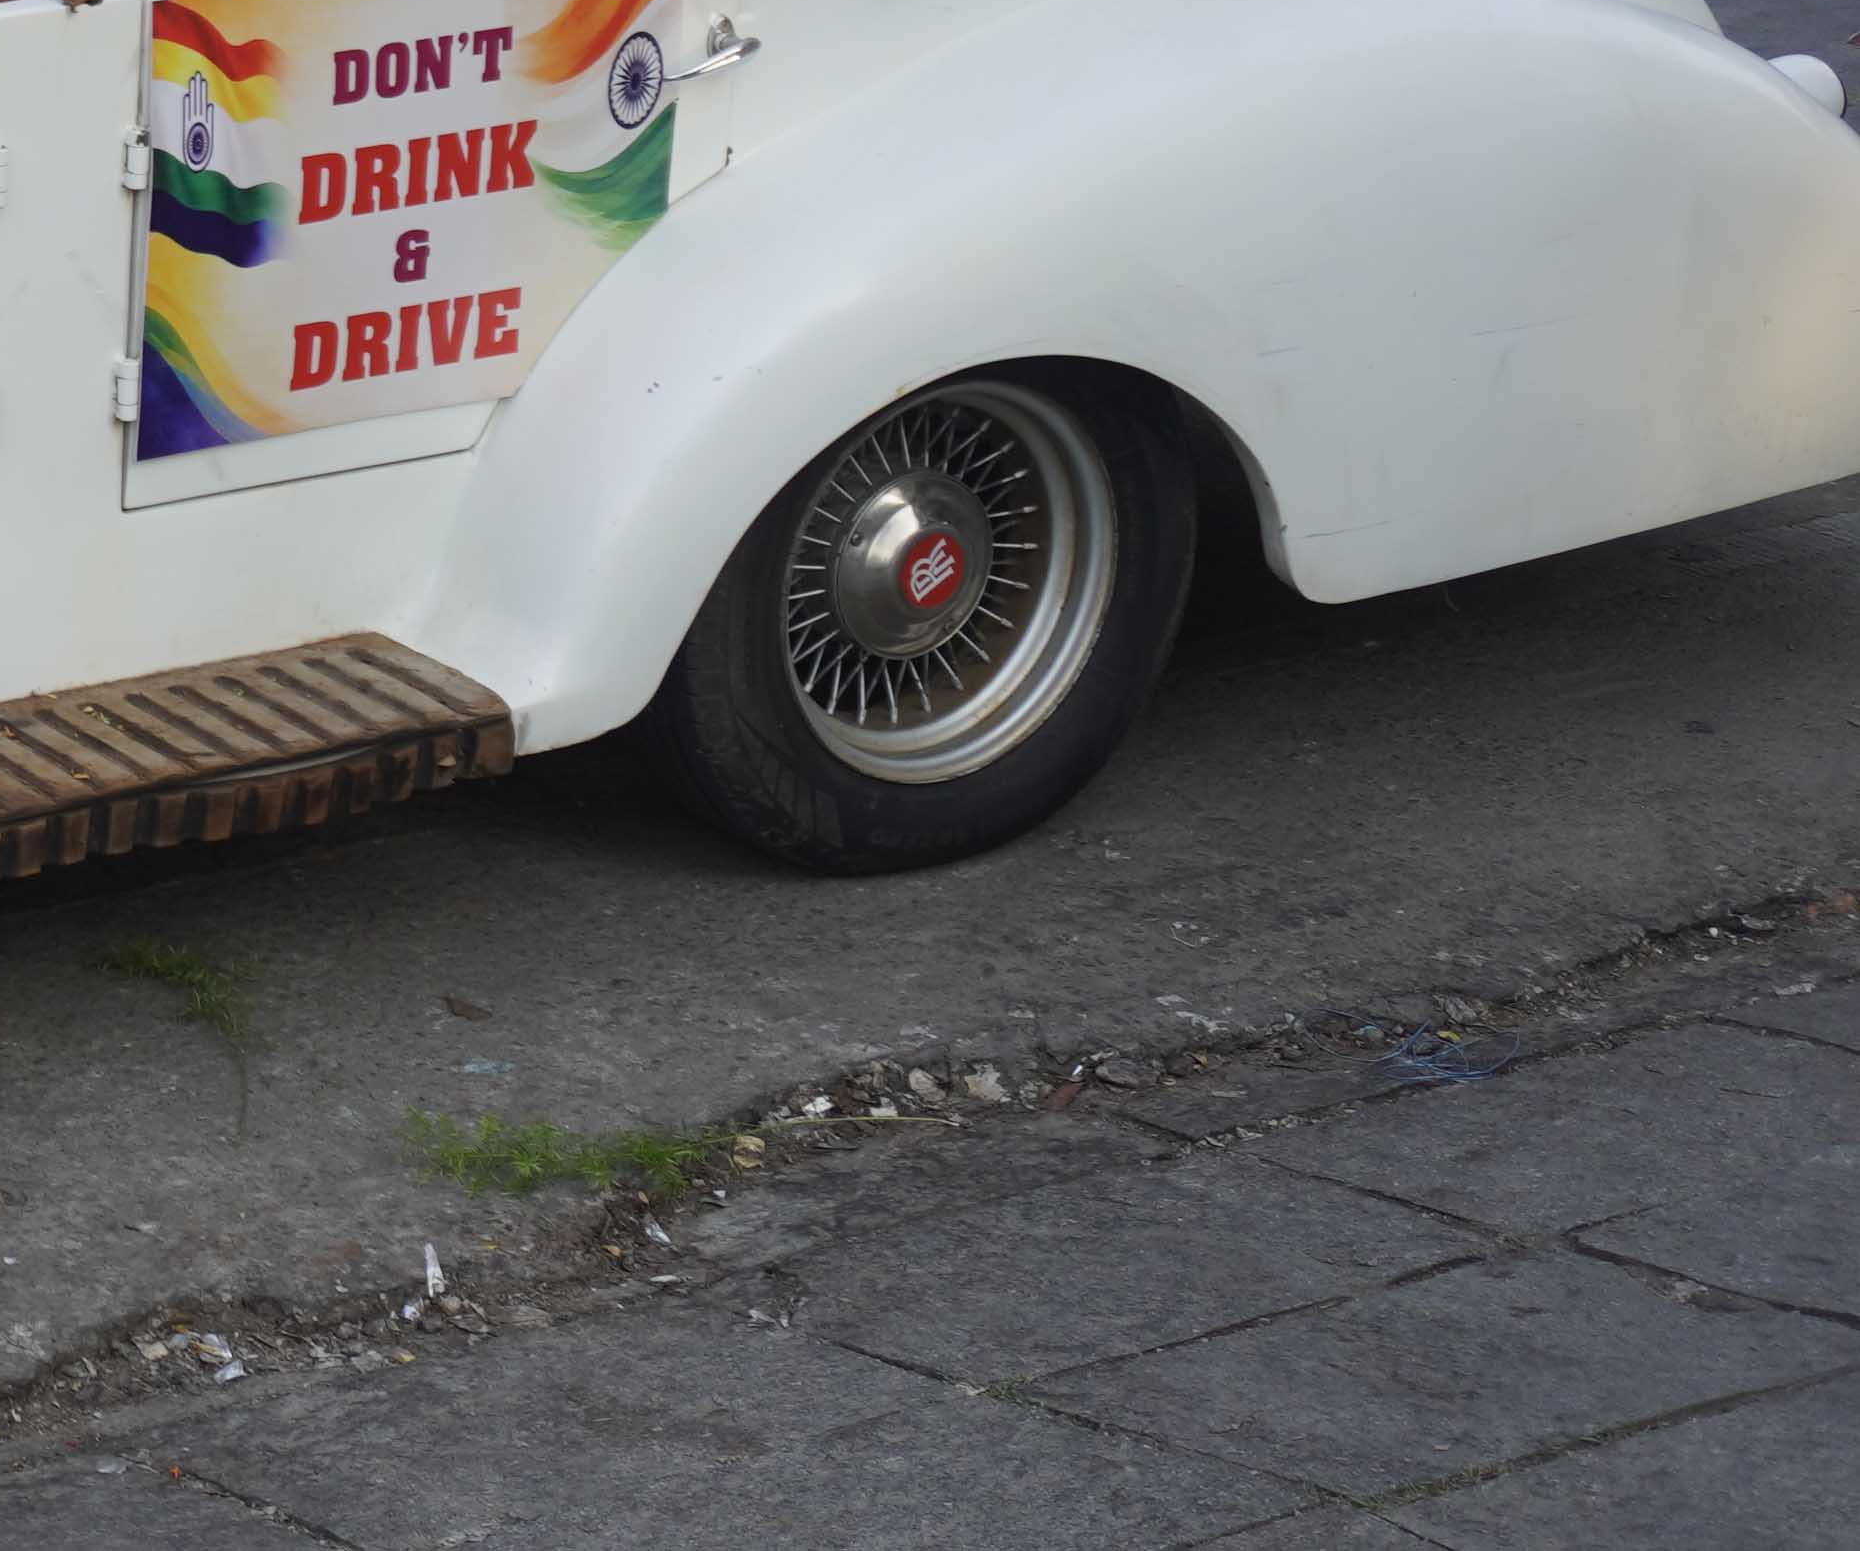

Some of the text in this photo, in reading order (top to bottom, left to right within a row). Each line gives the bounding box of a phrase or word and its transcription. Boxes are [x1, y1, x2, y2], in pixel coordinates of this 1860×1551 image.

[331, 26, 515, 107] DON'T
[297, 118, 539, 226] DRINK
[392, 228, 432, 284] &
[288, 286, 523, 392] DRIVE
